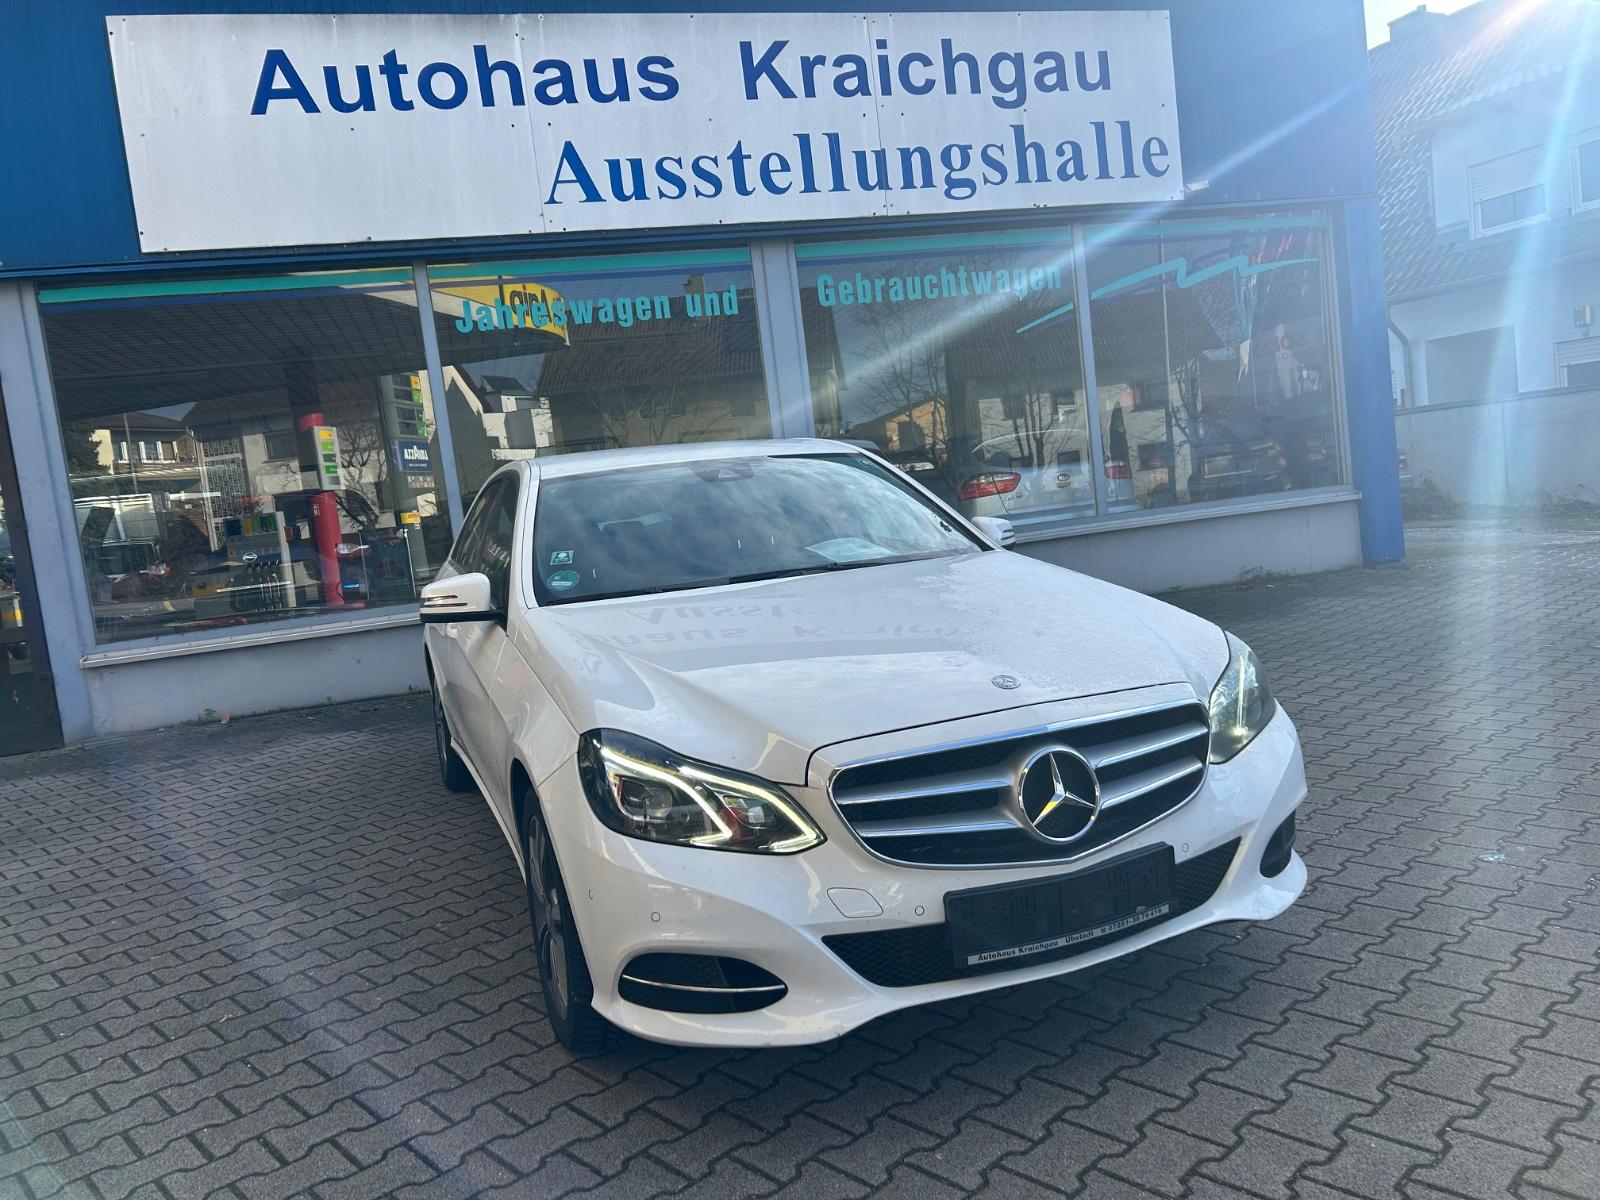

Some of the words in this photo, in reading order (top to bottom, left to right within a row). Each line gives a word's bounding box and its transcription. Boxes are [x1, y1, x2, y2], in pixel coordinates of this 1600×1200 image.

[251, 44, 679, 115] Autohaus
[741, 38, 1111, 109] Kraichgau
[547, 121, 1170, 206] Ausstellungshalle
[455, 291, 671, 334] Jahreswagen
[686, 285, 739, 318] und
[816, 263, 1063, 309] Gebrauchtwagen
[978, 950, 1016, 962] Autohaus
[1018, 940, 1059, 955] Kraichgau
